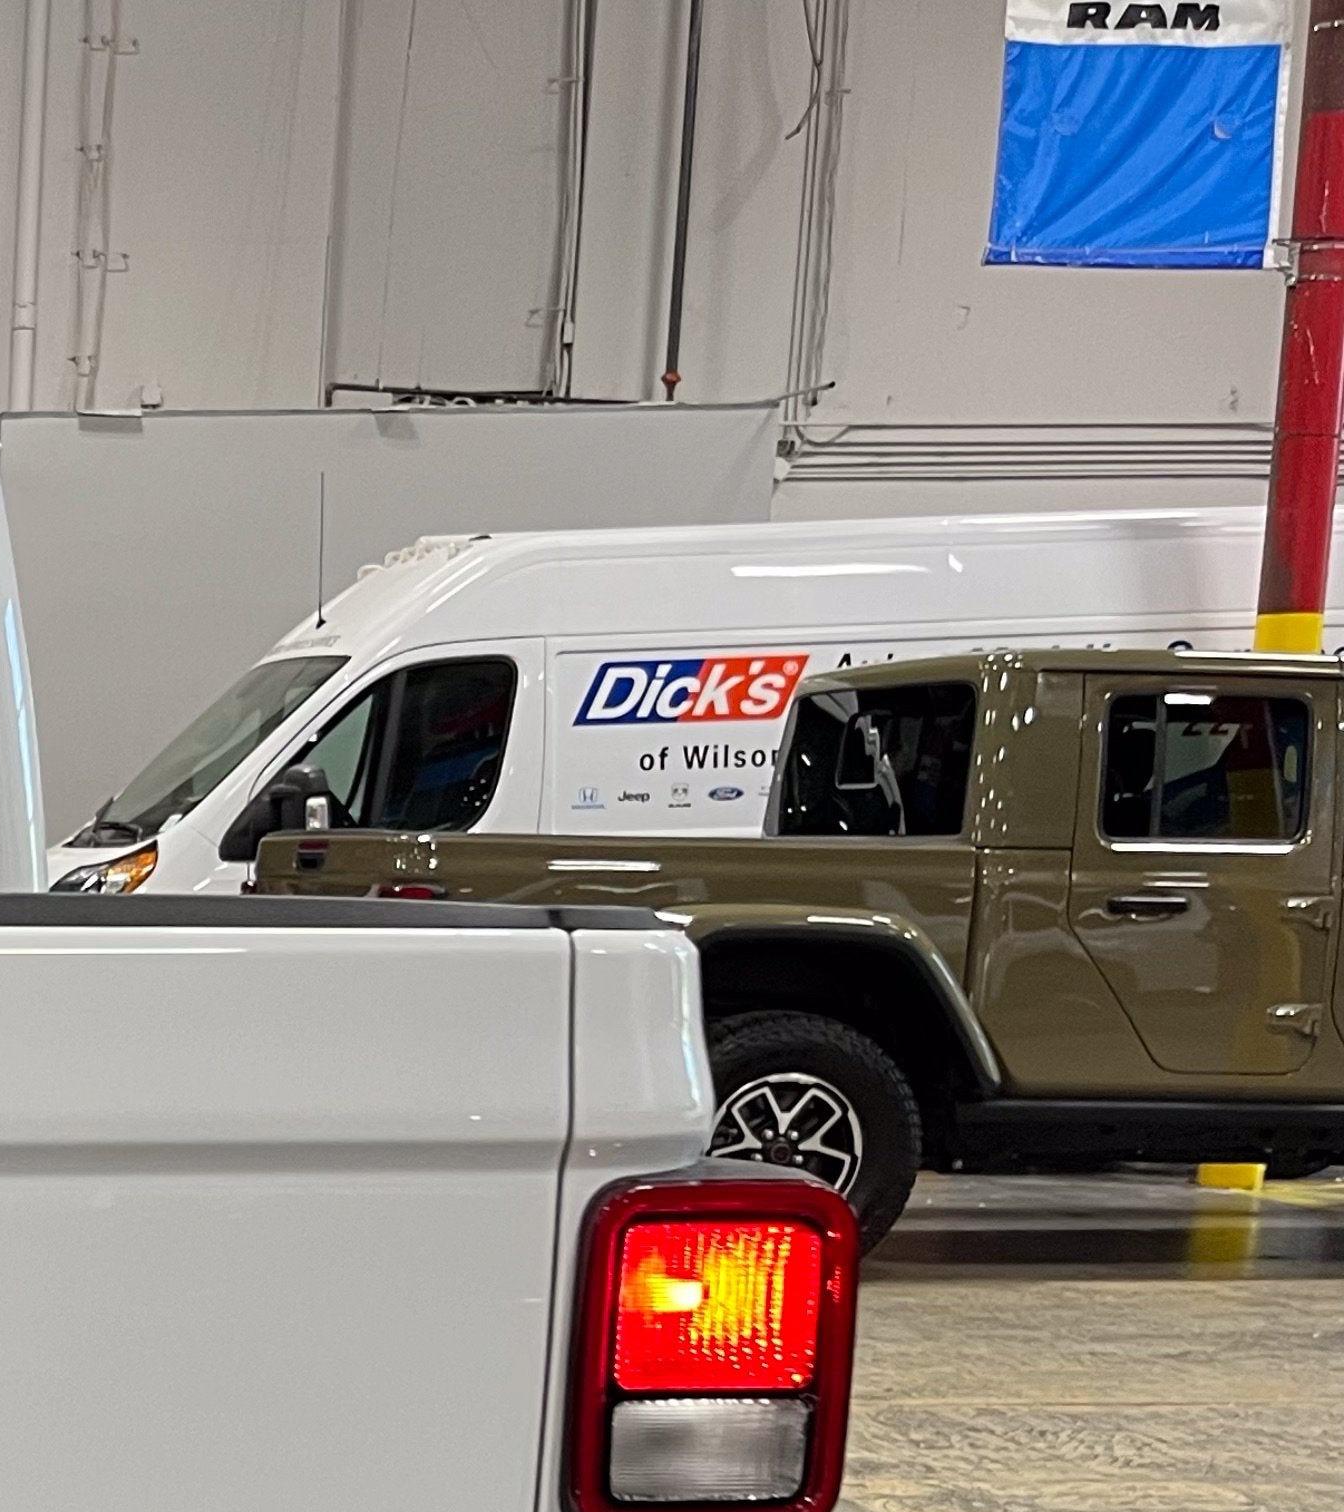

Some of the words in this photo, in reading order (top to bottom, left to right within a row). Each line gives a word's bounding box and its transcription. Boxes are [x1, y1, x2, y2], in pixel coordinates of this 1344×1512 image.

[1066, 2, 1222, 32] RAM
[639, 746, 670, 772] of
[617, 789, 651, 803] Jeep
